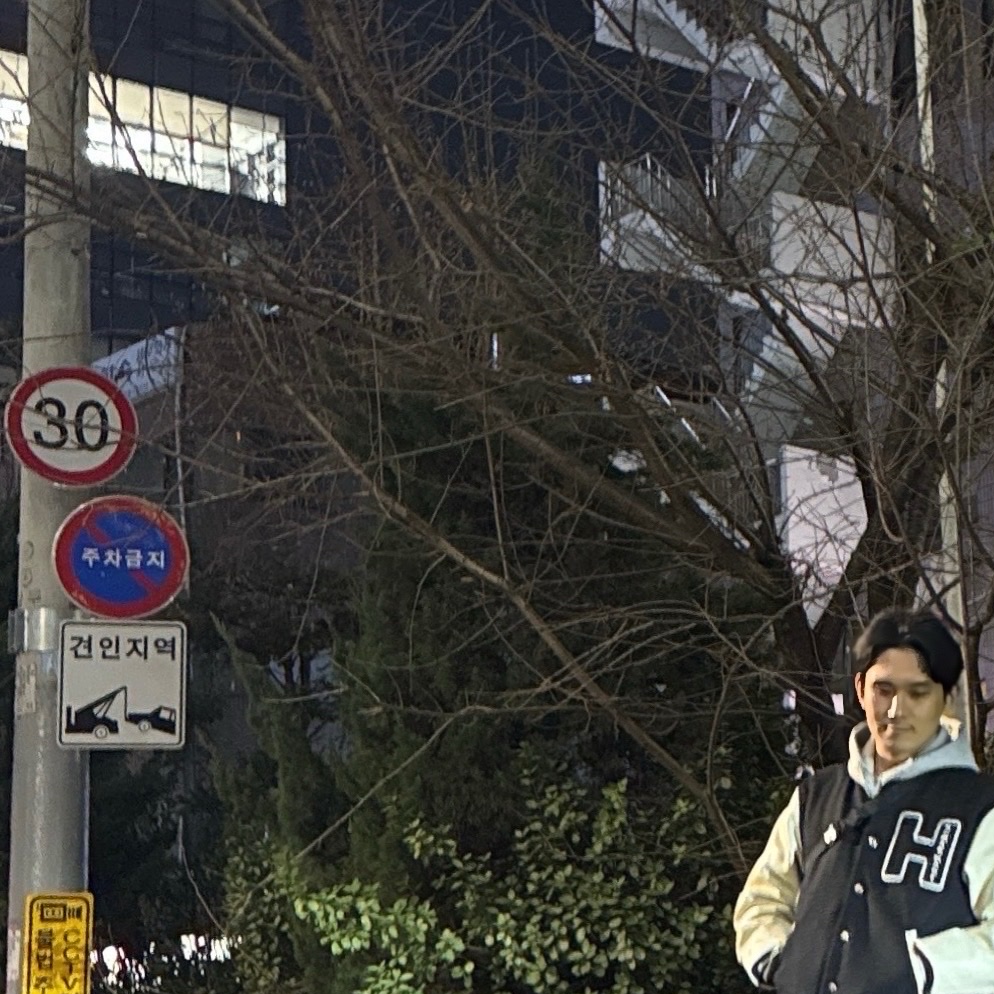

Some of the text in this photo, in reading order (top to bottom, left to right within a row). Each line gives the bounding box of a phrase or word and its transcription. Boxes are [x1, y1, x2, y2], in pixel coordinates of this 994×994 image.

[34, 397, 109, 452] 30
[82, 547, 165, 570] 주차금지
[70, 634, 176, 661] 견인지역
[881, 810, 962, 893] H
